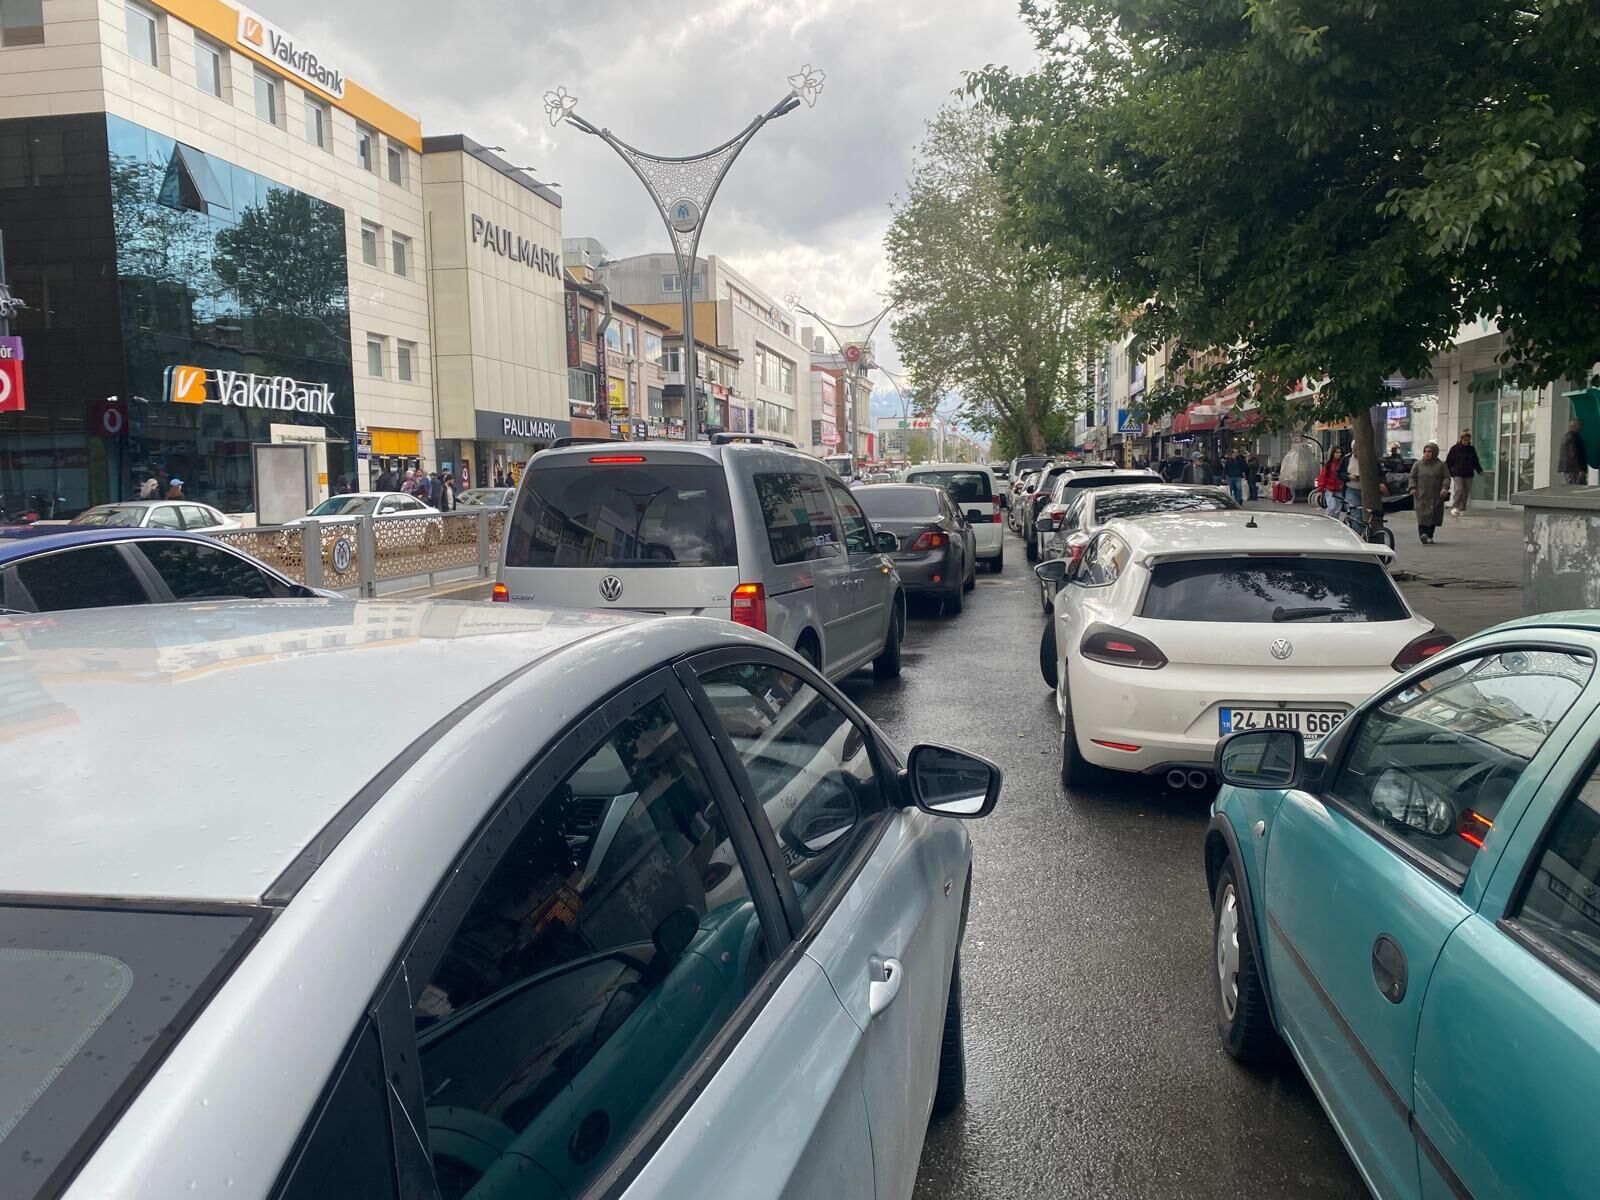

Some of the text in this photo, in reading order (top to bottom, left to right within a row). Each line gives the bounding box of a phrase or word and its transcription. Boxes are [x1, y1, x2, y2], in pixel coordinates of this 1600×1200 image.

[269, 29, 343, 94] VakıfBank
[471, 213, 562, 281] PAULMARK
[503, 417, 557, 439] PAULMARK
[1233, 712, 1256, 731] 24
